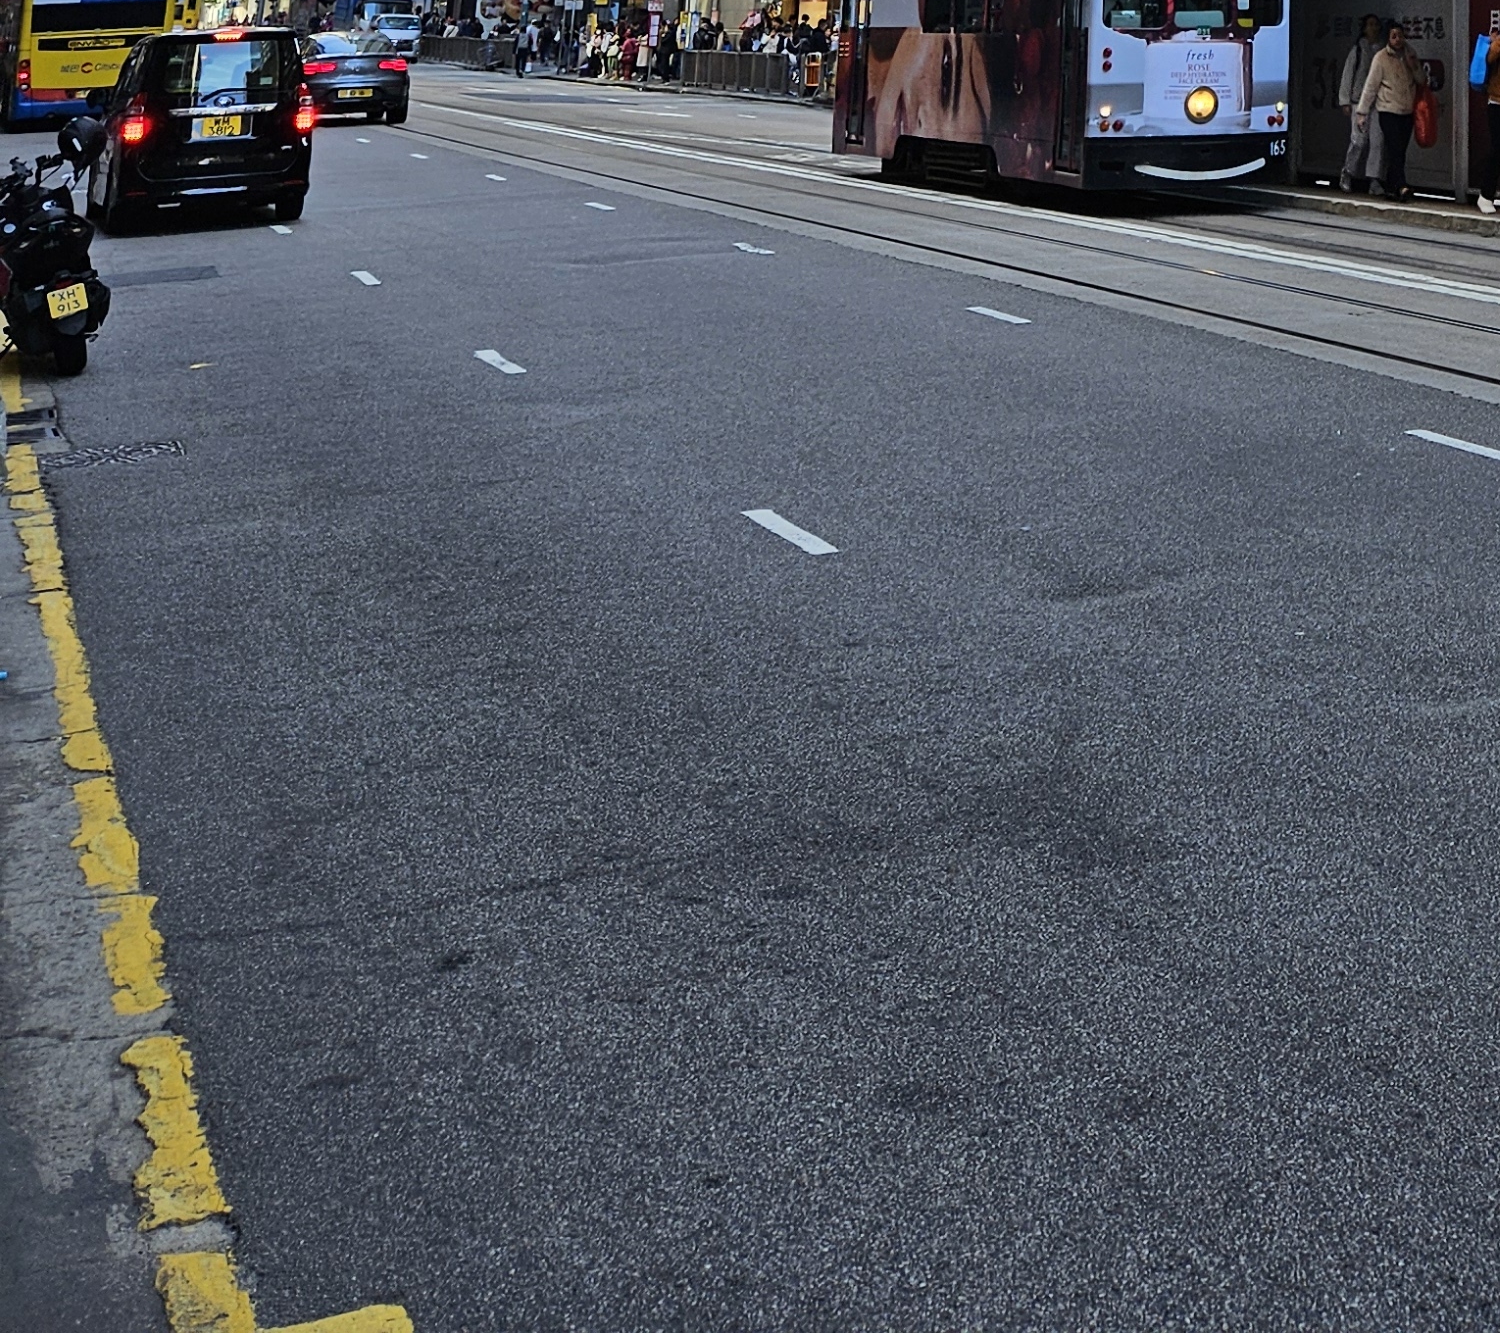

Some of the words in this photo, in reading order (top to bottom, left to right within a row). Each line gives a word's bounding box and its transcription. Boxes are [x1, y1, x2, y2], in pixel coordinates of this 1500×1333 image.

[1185, 49, 1215, 63] fresh
[1187, 63, 1211, 72] ROSE
[208, 126, 235, 136] 3812
[1270, 139, 1286, 156] 165
[58, 288, 76, 302] XH
[57, 300, 81, 313] 913
